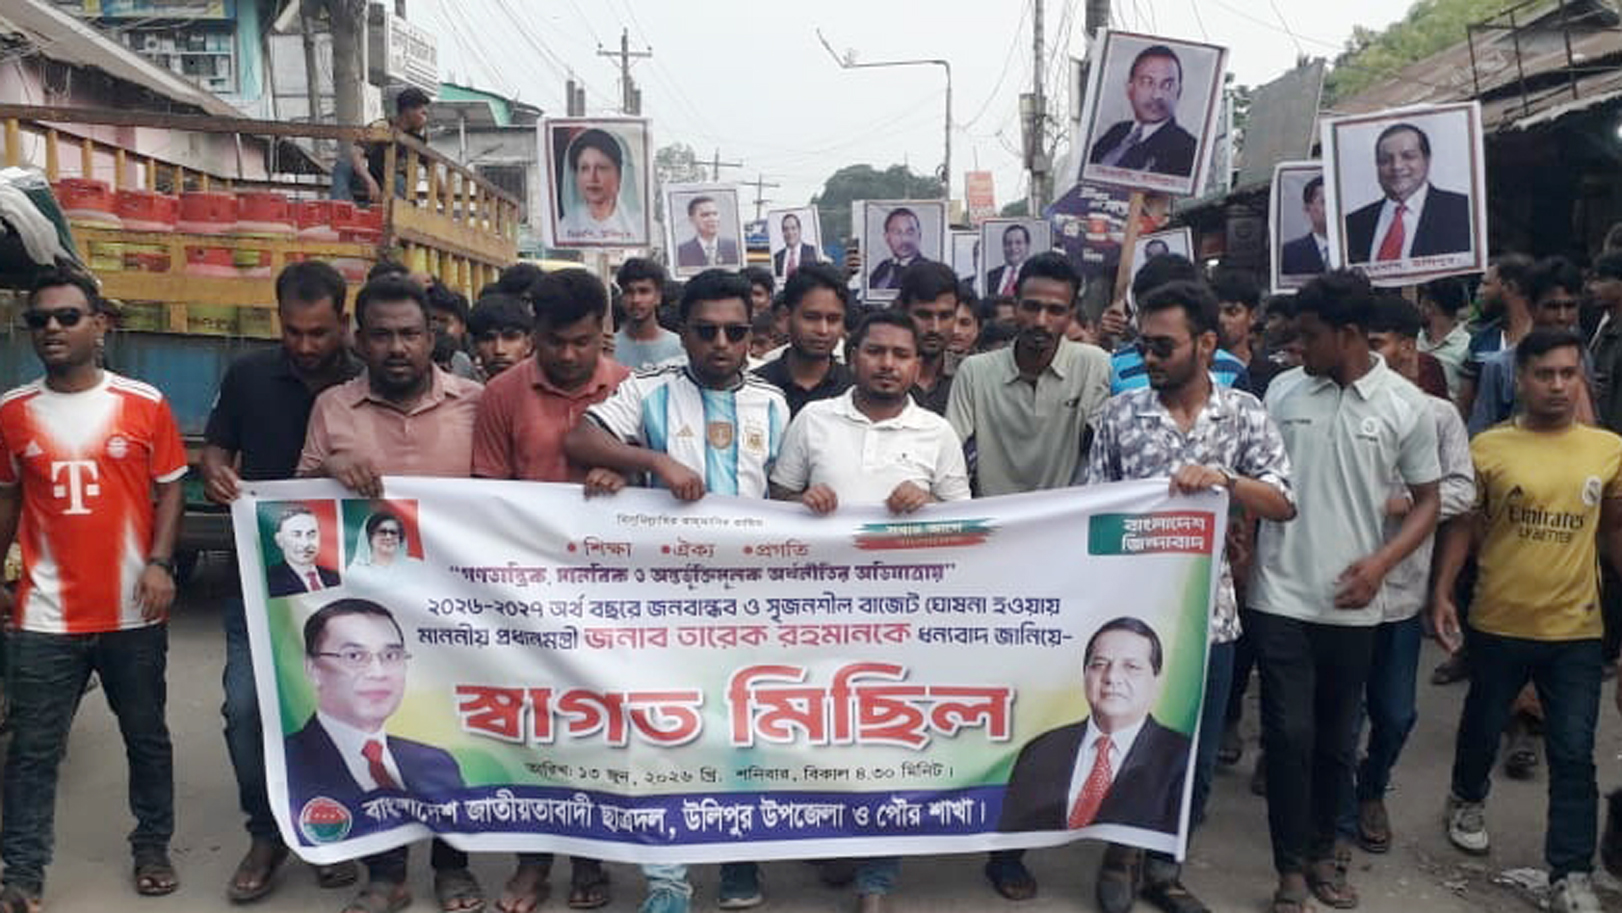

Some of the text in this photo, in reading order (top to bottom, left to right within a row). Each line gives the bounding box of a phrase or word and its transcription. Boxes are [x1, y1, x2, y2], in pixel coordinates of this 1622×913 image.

[1507, 506, 1585, 530] Emirates
[584, 536, 632, 558] শিক্ষা
[755, 539, 809, 559] প্রগতি
[633, 568, 645, 583] ও
[428, 597, 544, 619] ২০২৬-২০২৭
[549, 594, 584, 619] অর্থ
[589, 598, 642, 619] বছরে
[647, 598, 738, 619] জনবান্ধব
[744, 601, 760, 618] ও
[766, 591, 852, 623] সৃজনশীল
[858, 591, 920, 616] বাজেট
[417, 622, 490, 647] মাননীয়
[495, 624, 578, 651] প্রধানমন্ত্রী
[584, 626, 669, 651] জনাব
[676, 625, 769, 649] তারেক
[777, 622, 911, 648] রহমানকে
[918, 627, 989, 646] ধন্যবাদ
[453, 662, 1018, 750] স্বাগত মিছিল
[578, 767, 600, 779] ১৩
[644, 770, 694, 785] ২০২৬
[803, 764, 849, 780] বিকাল
[856, 768, 895, 780] ৪.৩০
[361, 795, 459, 824] বাংলাদেশ
[463, 789, 593, 827] জাতীয়তাবাদী
[682, 797, 754, 838] উলিপুর
[759, 798, 847, 829] উপজেলা
[852, 806, 869, 826] ও
[876, 796, 922, 827] পৌর
